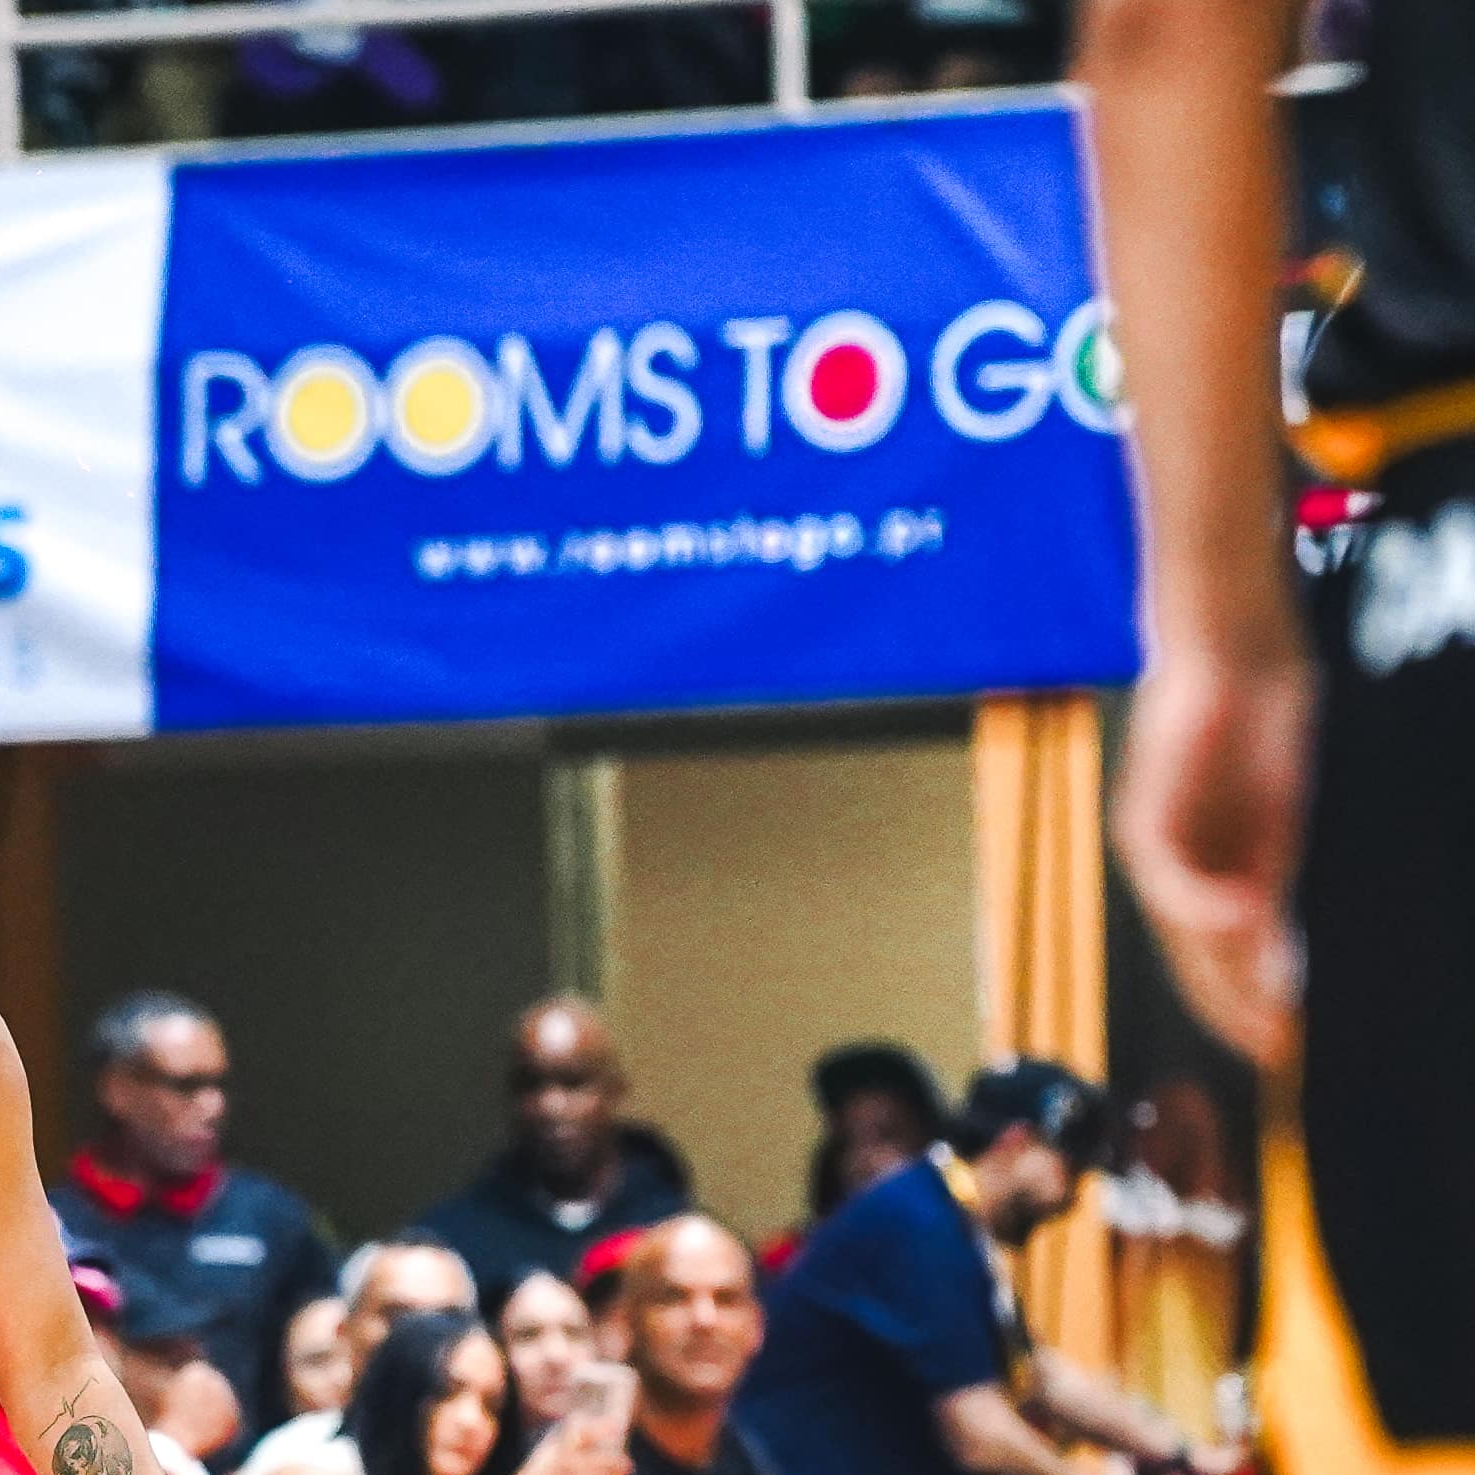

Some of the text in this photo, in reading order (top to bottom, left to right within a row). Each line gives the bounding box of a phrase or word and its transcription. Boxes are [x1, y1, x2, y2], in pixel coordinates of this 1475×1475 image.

[181, 297, 1135, 490] ROOMS TO GO
